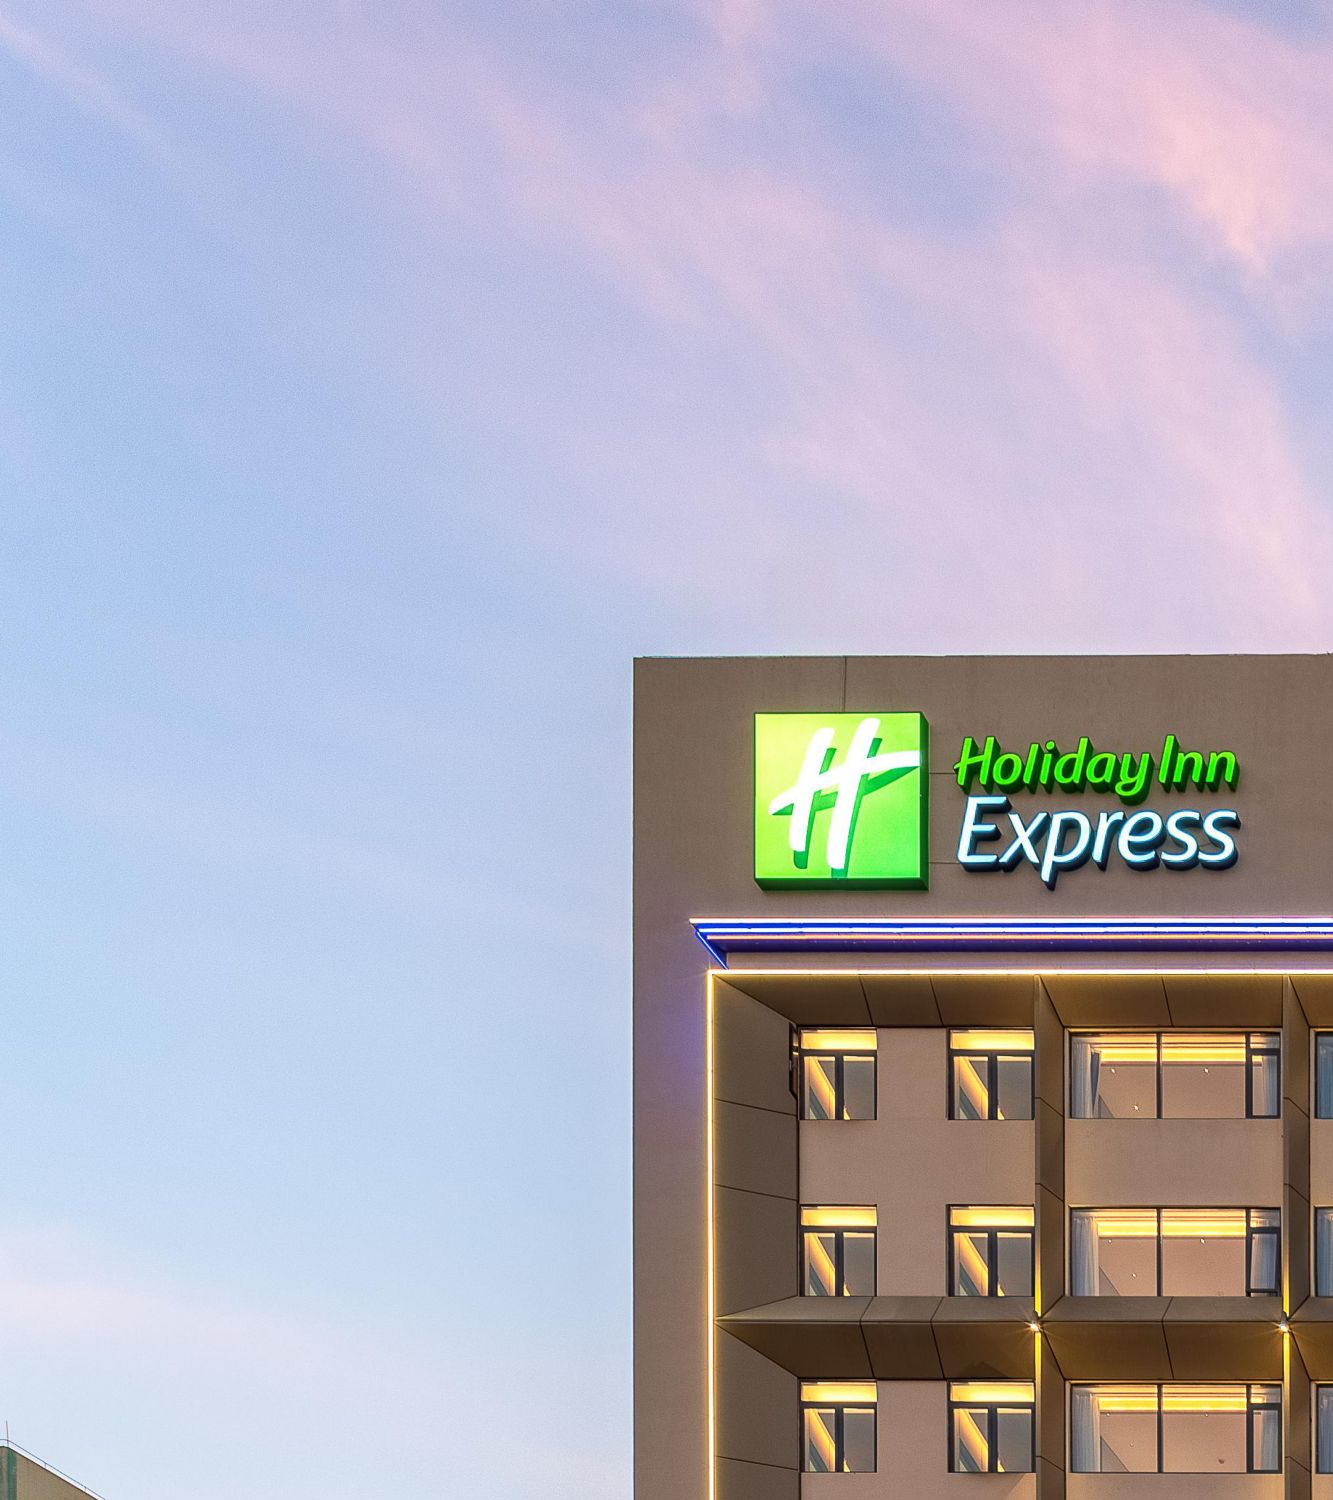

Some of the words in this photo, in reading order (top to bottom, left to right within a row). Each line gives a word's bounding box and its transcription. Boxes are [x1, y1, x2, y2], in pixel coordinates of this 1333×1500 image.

[953, 735, 1150, 805] Holiday
[1157, 734, 1240, 791] Inn
[956, 794, 1241, 884] Express
